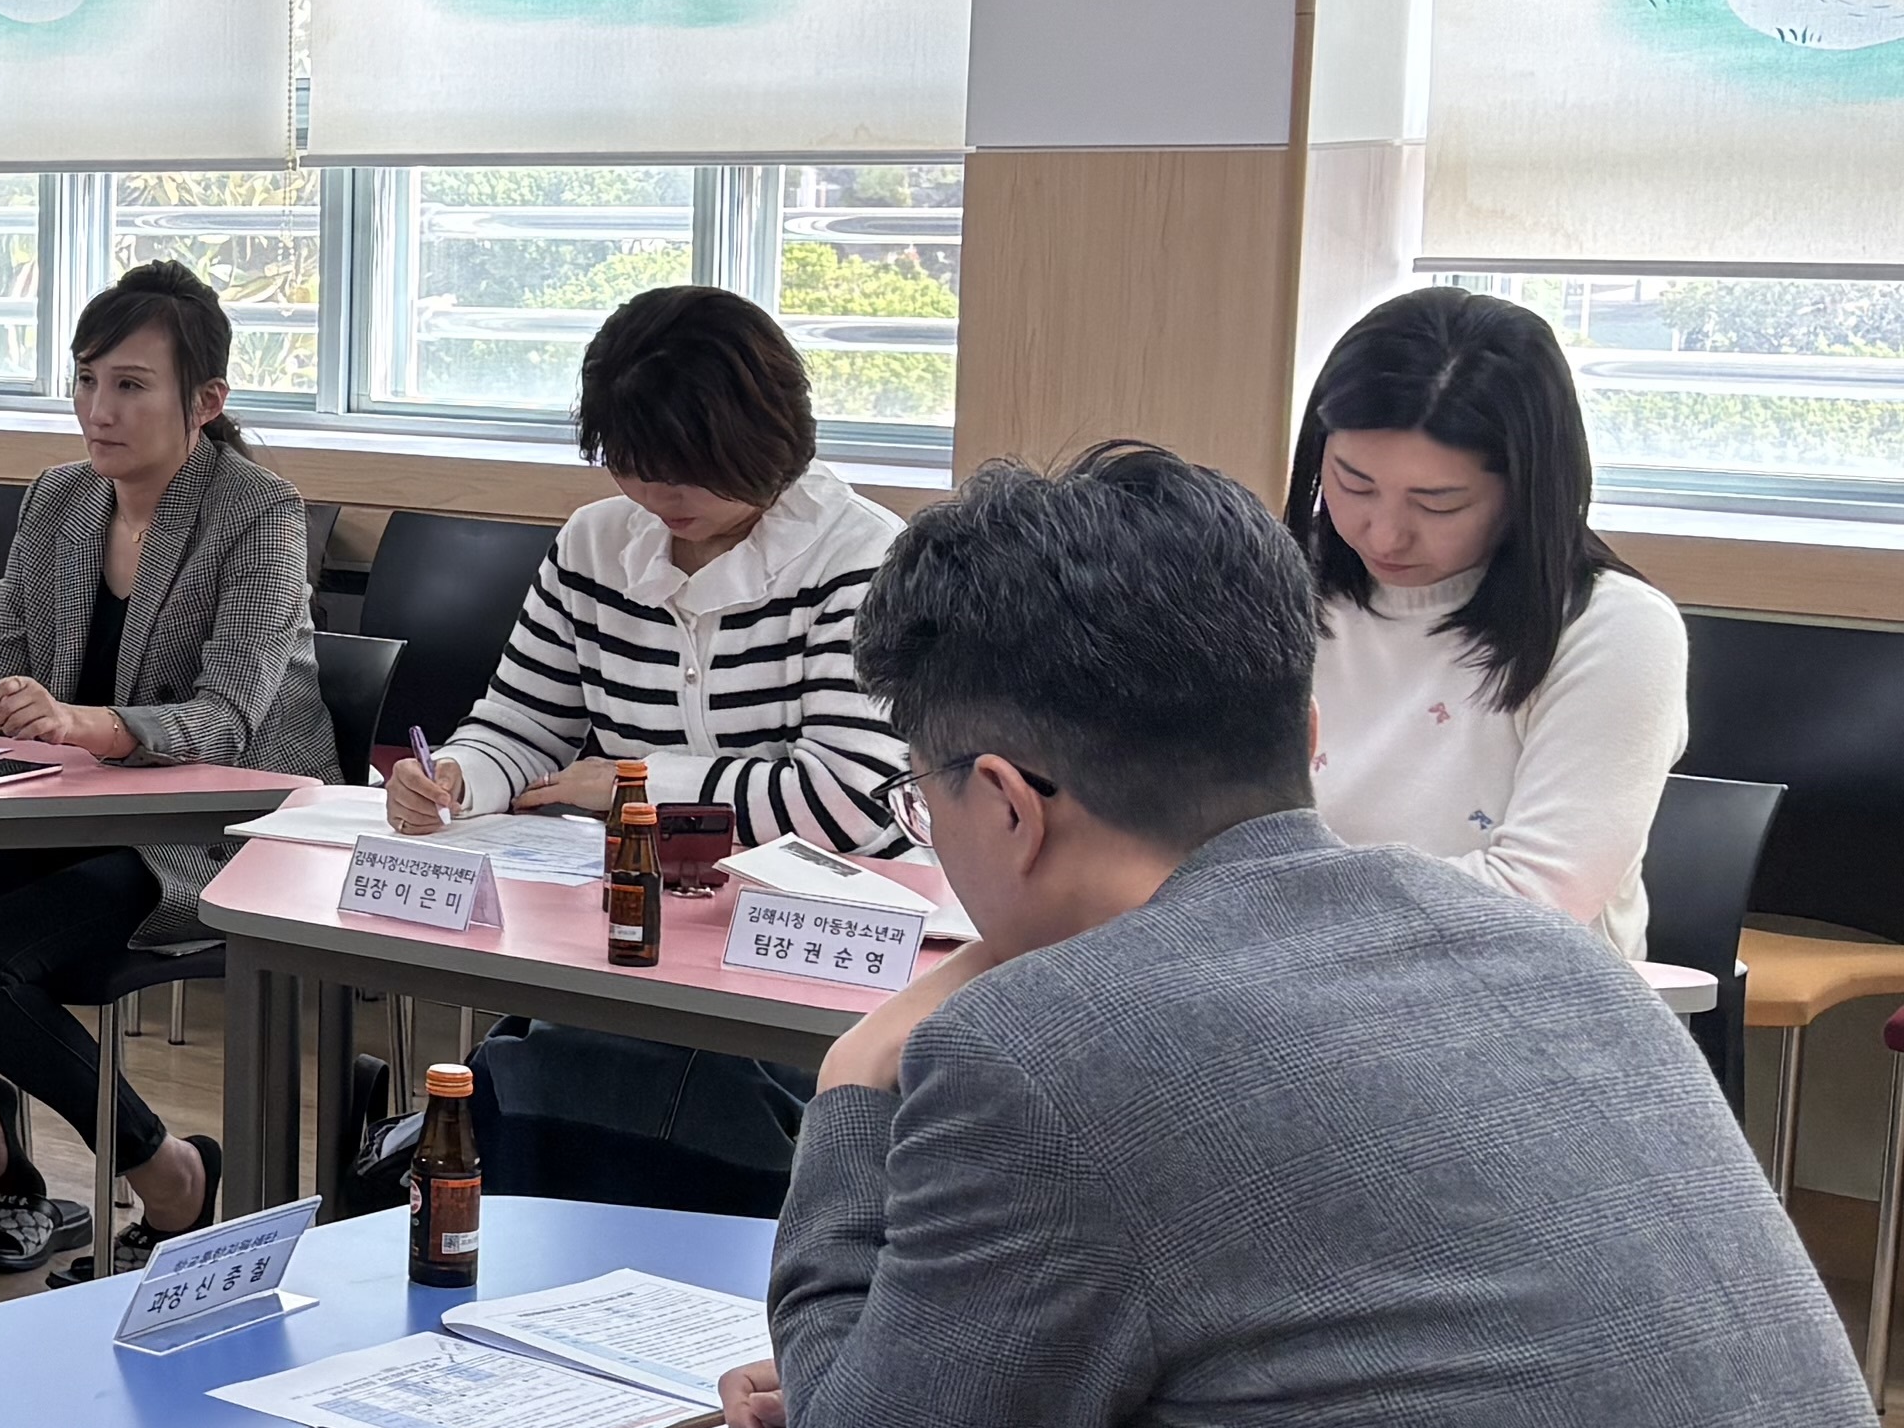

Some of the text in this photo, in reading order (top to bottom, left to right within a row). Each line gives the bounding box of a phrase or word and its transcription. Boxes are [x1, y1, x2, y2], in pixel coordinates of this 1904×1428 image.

[354, 875, 462, 915] 팀장 이은미
[748, 906, 906, 945] 김해시청 아동청소년과
[753, 933, 885, 975] 팀장 권순영
[146, 1282, 188, 1314] 과장
